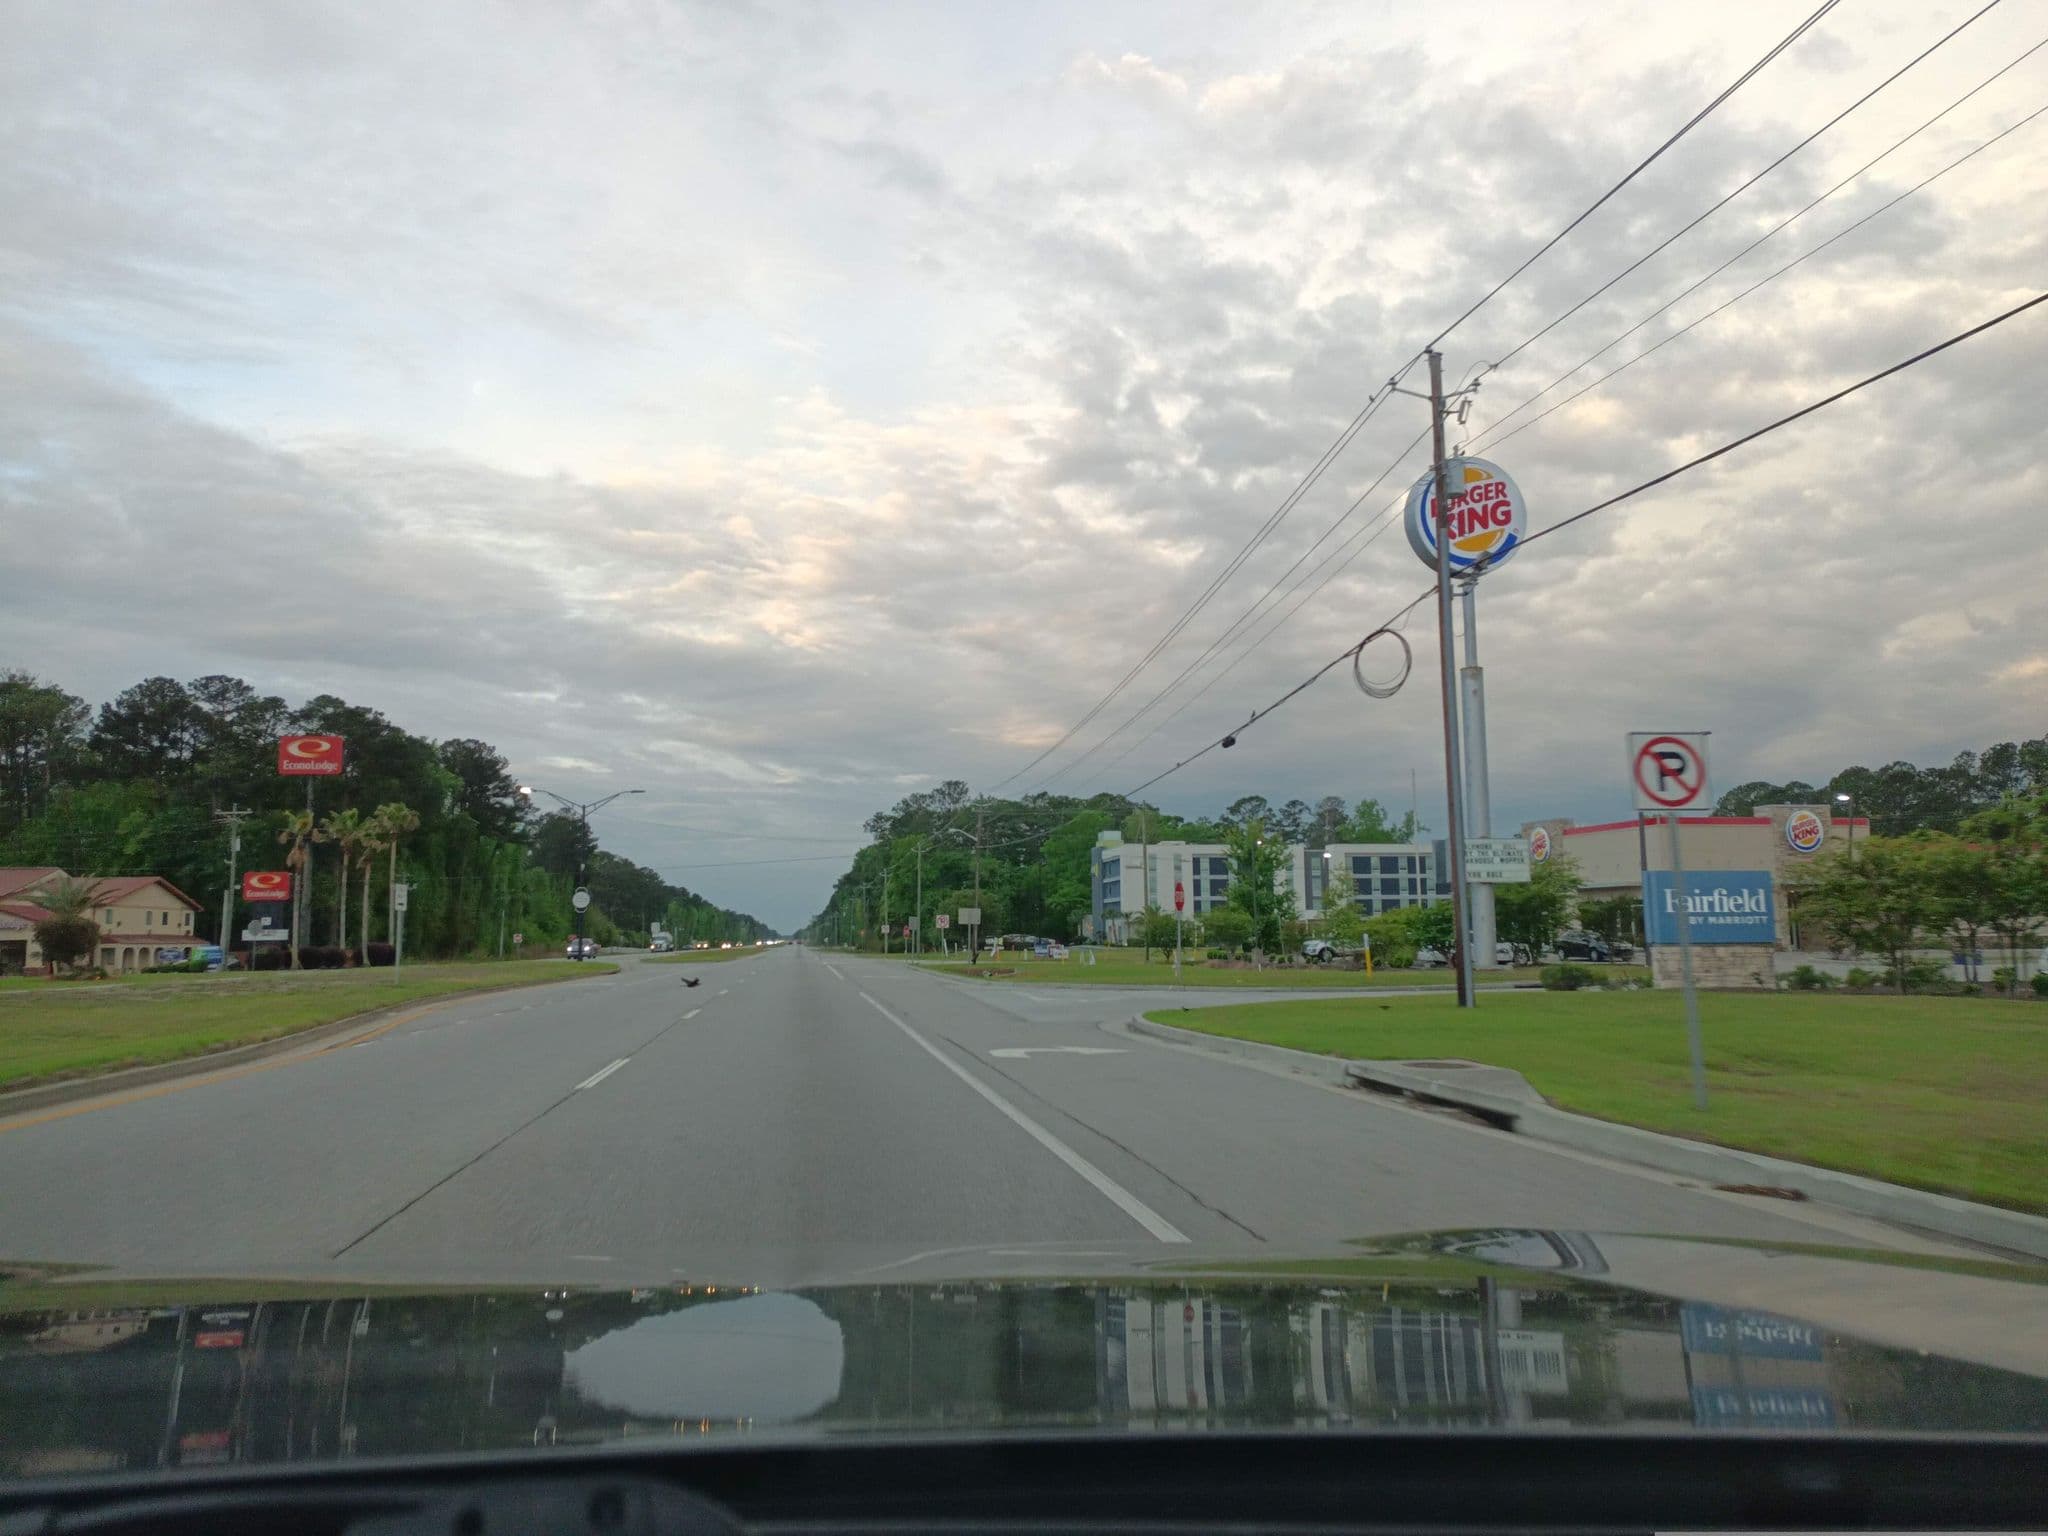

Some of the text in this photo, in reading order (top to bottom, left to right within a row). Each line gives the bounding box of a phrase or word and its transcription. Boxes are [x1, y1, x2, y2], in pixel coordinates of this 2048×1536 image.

[1793, 825, 1819, 840] KING
[1664, 887, 1768, 913] Fairfield
[1689, 915, 1769, 925] BY MARRIOTT
